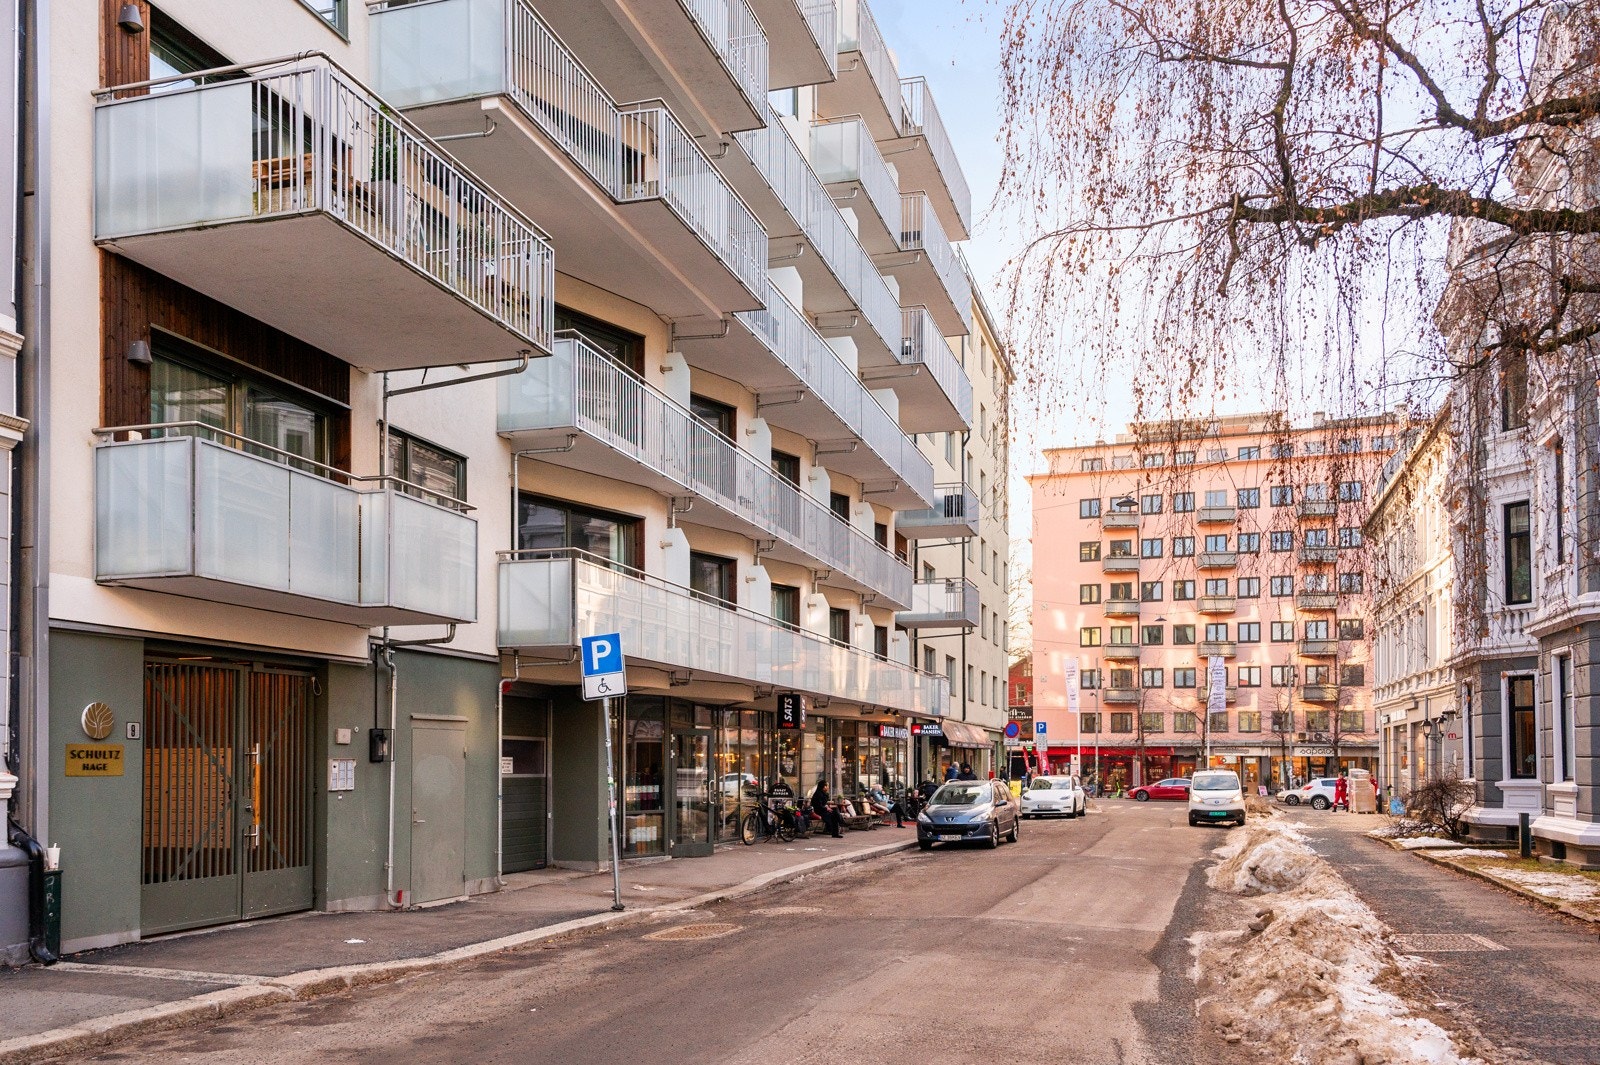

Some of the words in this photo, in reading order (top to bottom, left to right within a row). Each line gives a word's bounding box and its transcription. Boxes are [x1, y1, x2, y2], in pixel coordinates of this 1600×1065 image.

[591, 639, 612, 671] P
[784, 697, 793, 722] SATS
[1038, 723, 1045, 733] P
[70, 749, 121, 760] SCHULTZ
[82, 763, 109, 771] HAGE
